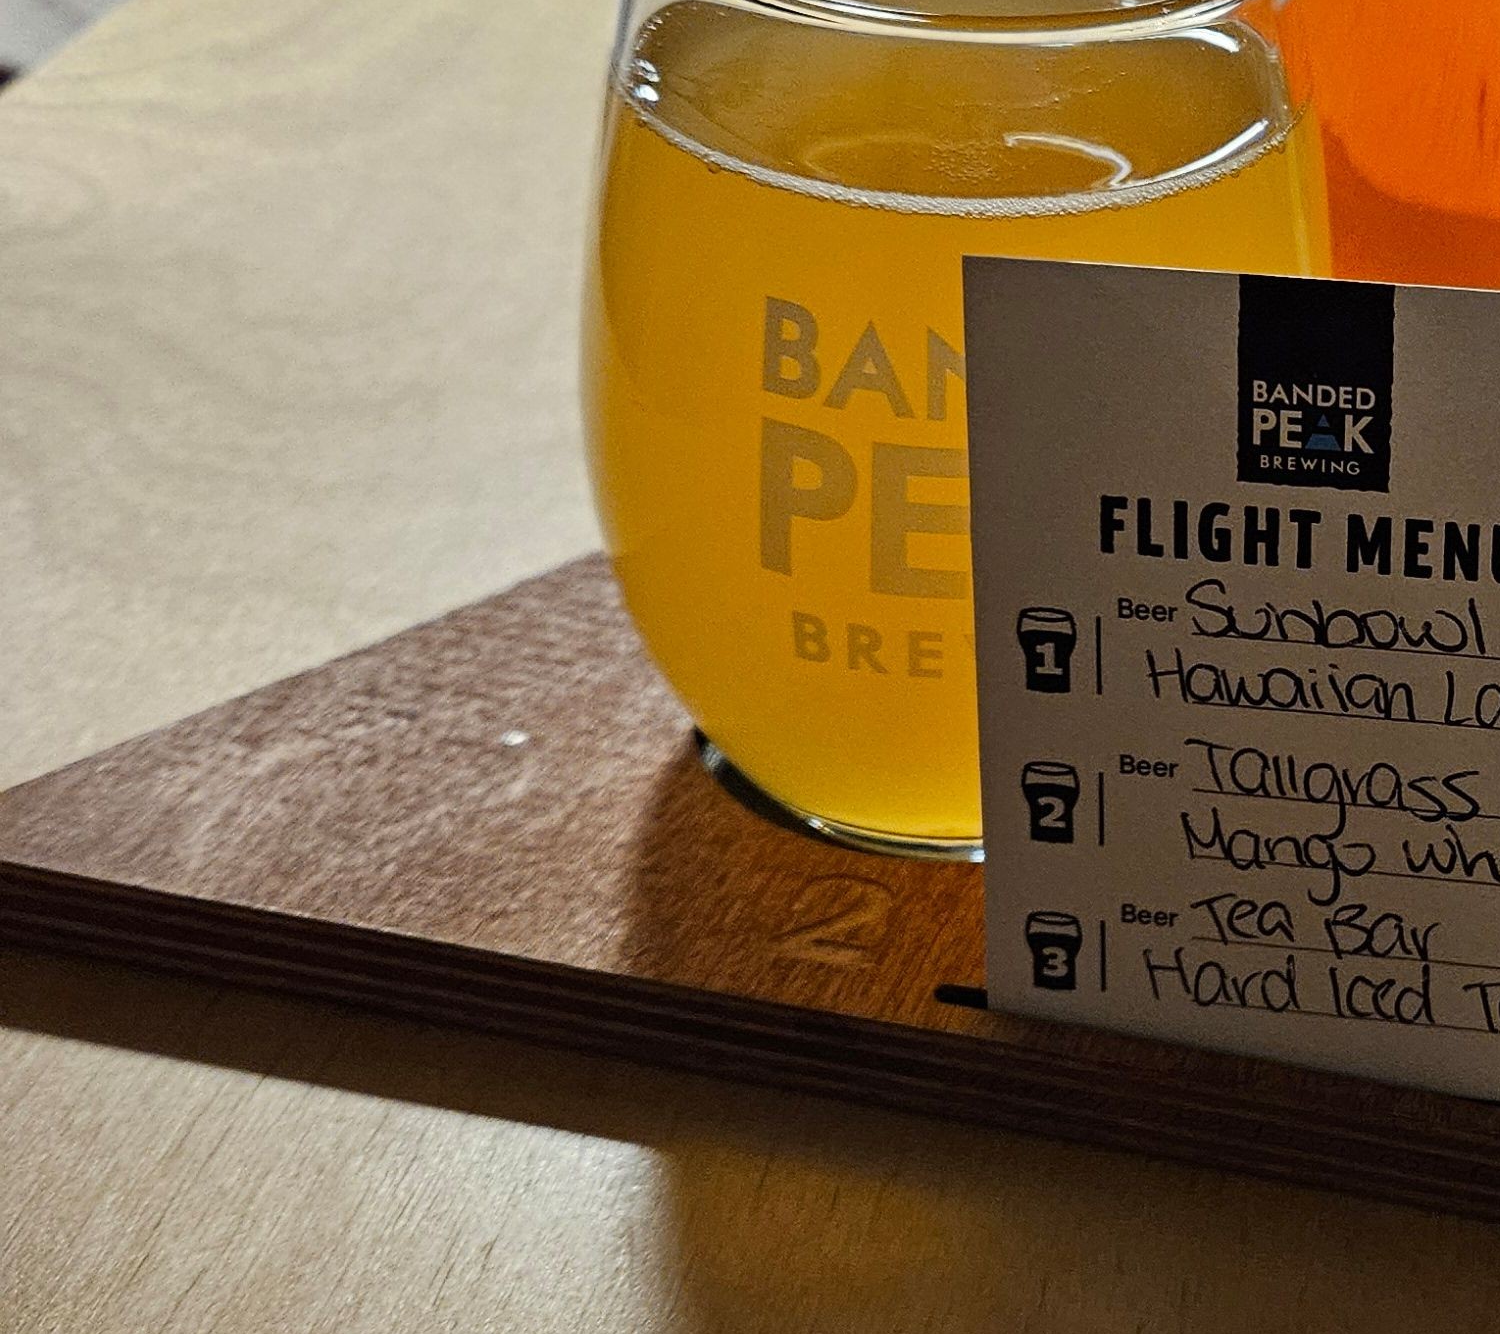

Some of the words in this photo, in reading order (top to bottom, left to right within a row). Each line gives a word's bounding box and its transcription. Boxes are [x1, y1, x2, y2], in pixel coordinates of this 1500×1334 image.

[1253, 380, 1376, 410] BANDED
[1252, 408, 1375, 454] PEAK
[1260, 454, 1361, 476] BREWING
[1100, 495, 1321, 570] FLIGHT
[1117, 597, 1178, 624] Beer
[1185, 578, 1488, 656] Sunbowl
[792, 610, 974, 679] BRE
[1034, 641, 1065, 676] 1
[1147, 647, 1417, 721] Hawaiian
[1119, 753, 1178, 779] Beer
[1184, 738, 1482, 836] Tallgrass
[1037, 797, 1067, 829] 2
[1180, 807, 1377, 906] Mango
[1121, 903, 1179, 928] Beer
[1191, 892, 1295, 942] Tea
[1323, 903, 1441, 961] Bar
[1040, 946, 1069, 977] 3
[1142, 947, 1301, 1012] Hard
[1331, 962, 1435, 1025] Iced
